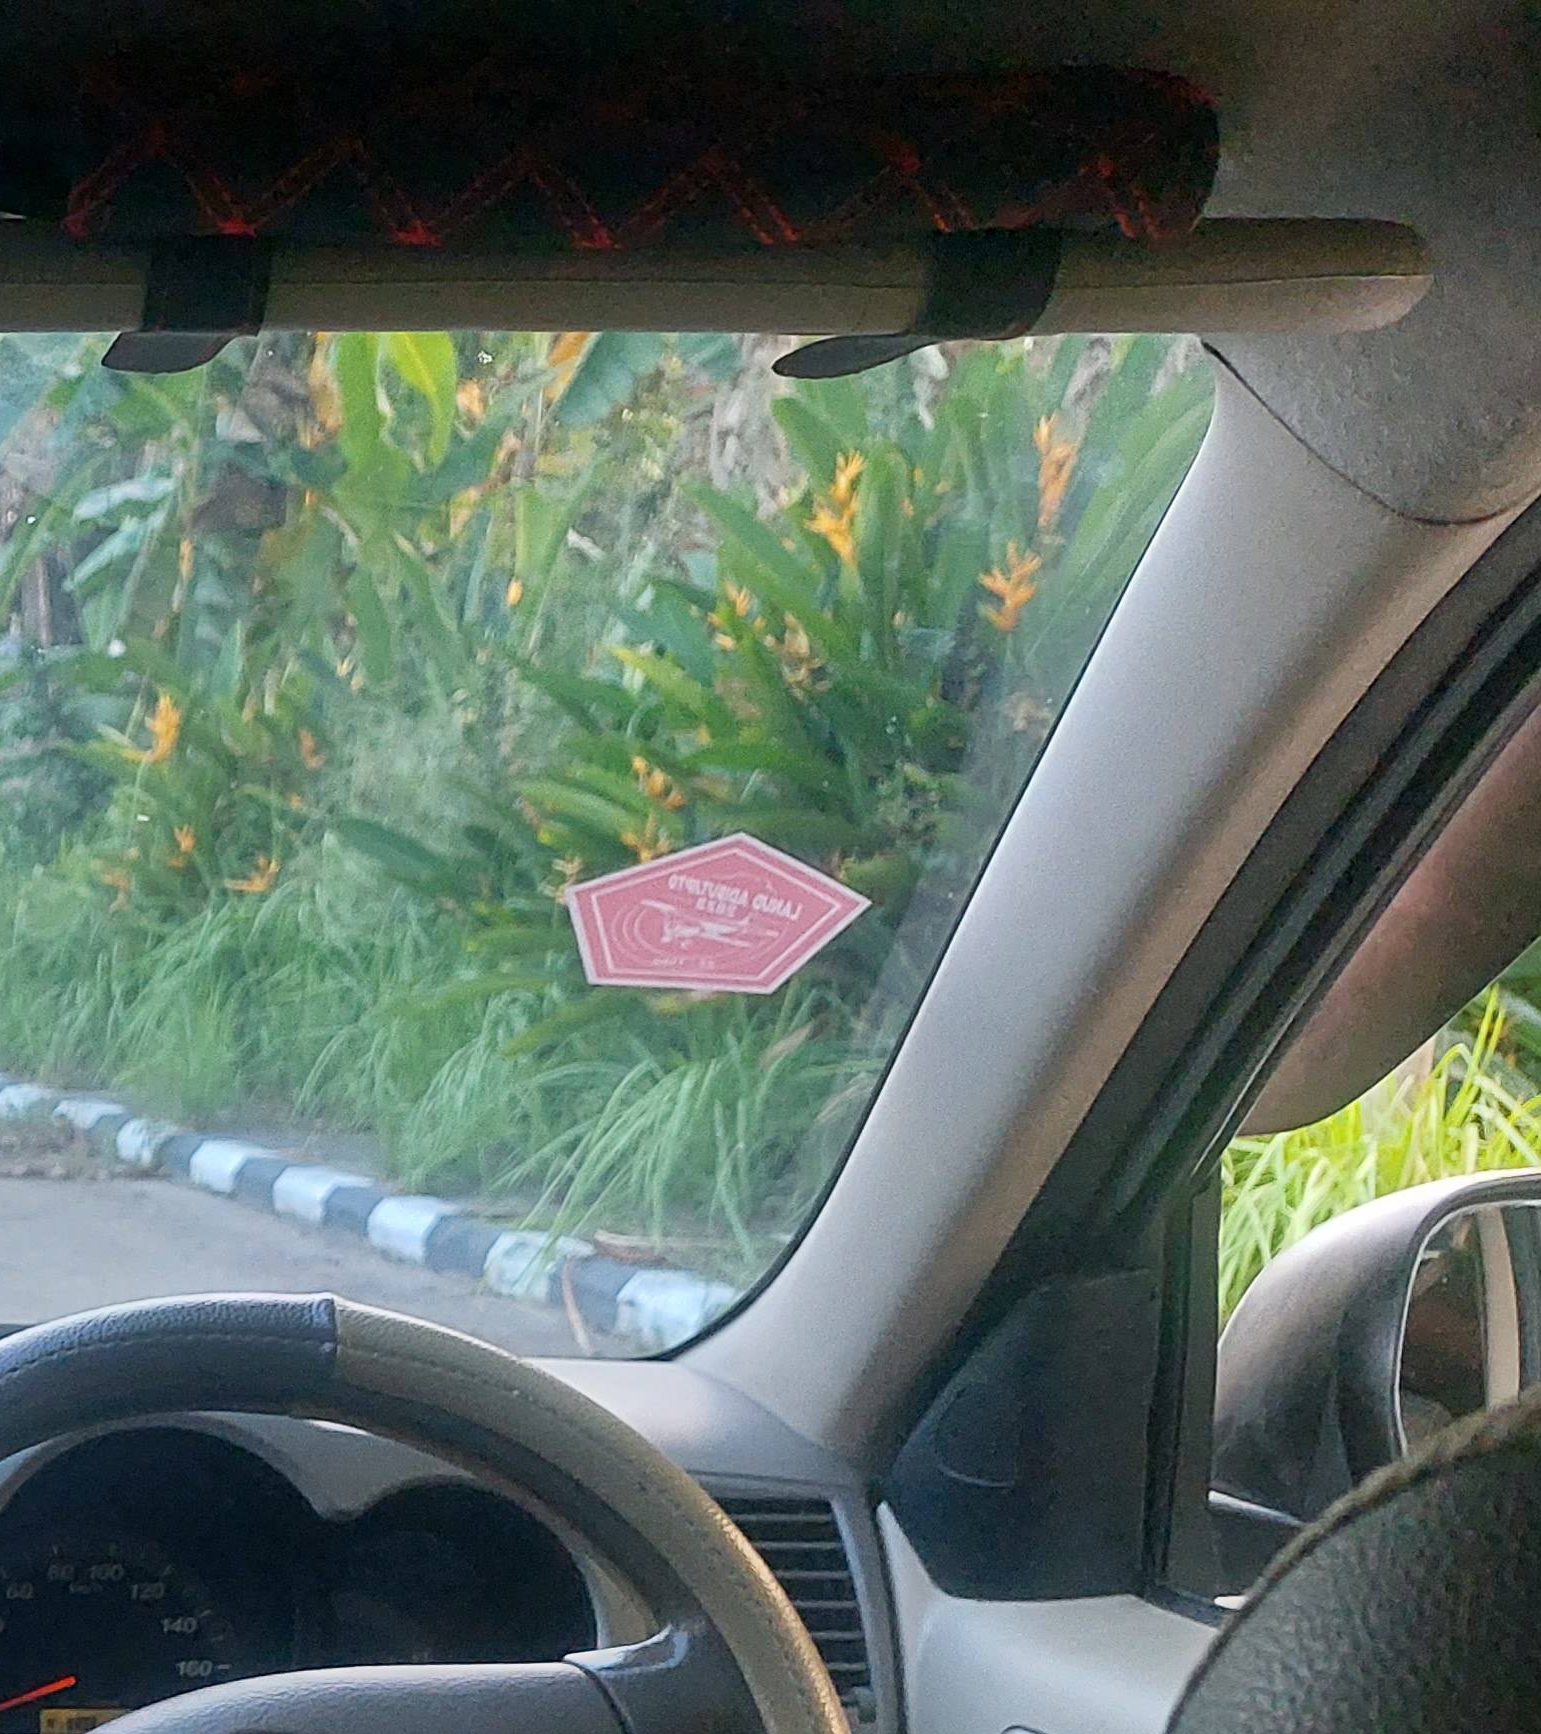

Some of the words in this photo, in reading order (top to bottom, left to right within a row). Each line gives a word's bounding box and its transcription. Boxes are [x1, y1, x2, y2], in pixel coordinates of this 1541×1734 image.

[90, 1562, 125, 1581] 100
[130, 1583, 166, 1601] 120
[161, 1616, 199, 1635] 140
[175, 1660, 214, 1678] 160
